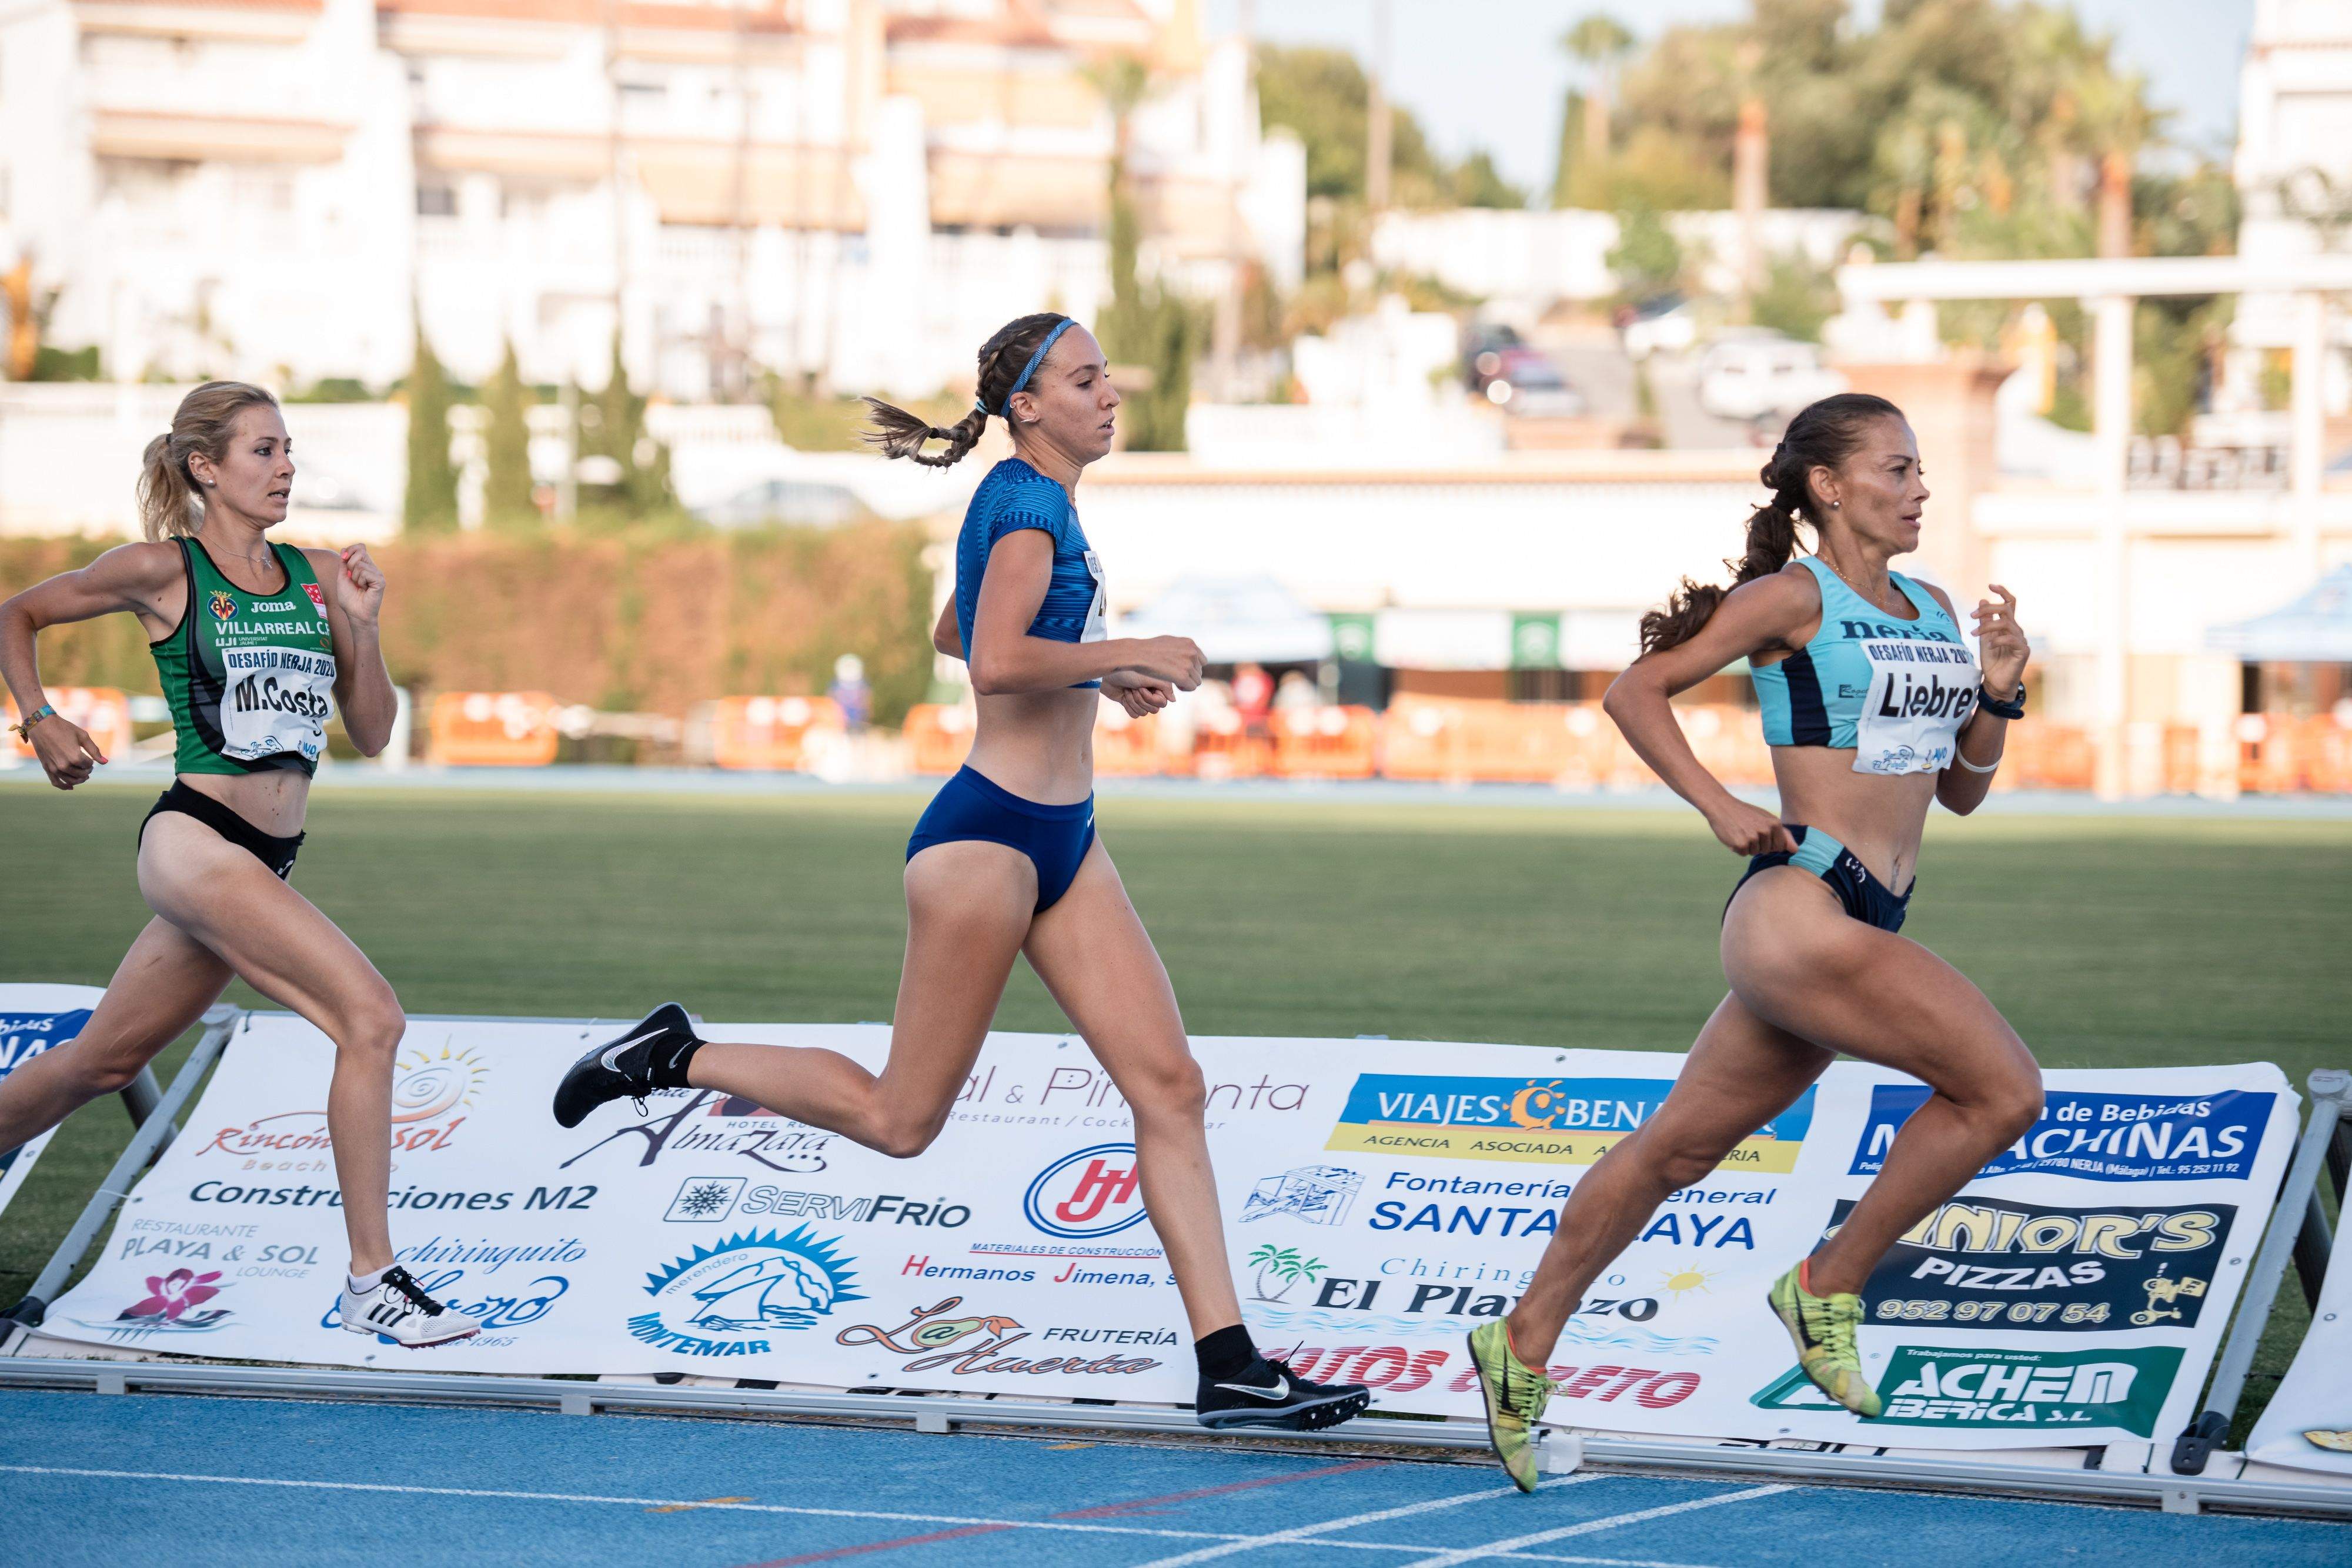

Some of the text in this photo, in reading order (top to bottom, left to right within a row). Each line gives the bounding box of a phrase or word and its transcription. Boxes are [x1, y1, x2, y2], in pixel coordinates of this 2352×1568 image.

[251, 601, 296, 613] Joma
[215, 621, 315, 635] VILLARREAL
[280, 653, 312, 673] NERJA
[314, 659, 335, 677] 2020
[1915, 646, 1952, 663] NERJA
[235, 674, 328, 718] M.Costa
[1004, 1085, 1024, 1104] &
[948, 1110, 1062, 1124] Restaurant
[1377, 1091, 1501, 1128] VIAJES
[2056, 1101, 2093, 1122] de
[2099, 1101, 2211, 1122] Bebidas
[726, 1120, 777, 1129] HOTEL
[196, 1126, 331, 1156] Rincón
[1363, 1135, 1450, 1150] AGENCIA
[1470, 1140, 1574, 1156] ASOCIADA
[241, 1159, 327, 1172] Beach
[2070, 1158, 2104, 1174] NERJA
[2105, 1162, 2149, 1178] (Málaga)
[2177, 1165, 2191, 1175] 95
[2191, 1164, 2211, 1174] 252
[2211, 1164, 2223, 1172] 11
[2224, 1163, 2240, 1173] 92
[523, 1185, 599, 1211] M2
[1385, 1171, 1778, 1205] Fontanería eneral
[131, 1219, 260, 1238] RESTAURANTE
[119, 1236, 320, 1264] PLAYA & SOL
[395, 1236, 587, 1275] chiringuito
[971, 1243, 1163, 1256] MATERIALES DE CONSTRUCCIÓN
[236, 1266, 311, 1278] LOUNGE
[664, 1252, 749, 1295] merendero
[900, 1254, 1035, 1283] Hermanos
[1054, 1262, 1155, 1288] Jimena,
[1910, 1257, 2107, 1290] PIZZAS
[1311, 1277, 1384, 1310] El
[1876, 1299, 2111, 1323] 952 97 07 54
[470, 1336, 520, 1347] 1965
[627, 1311, 771, 1357] MONTEMAR
[1043, 1328, 1178, 1346] FRUTERÍA
[901, 1332, 1163, 1375] Huerta
[1906, 1349, 2042, 1362] Trabajamos para usted:
[1890, 1362, 2139, 1405] ACHEM
